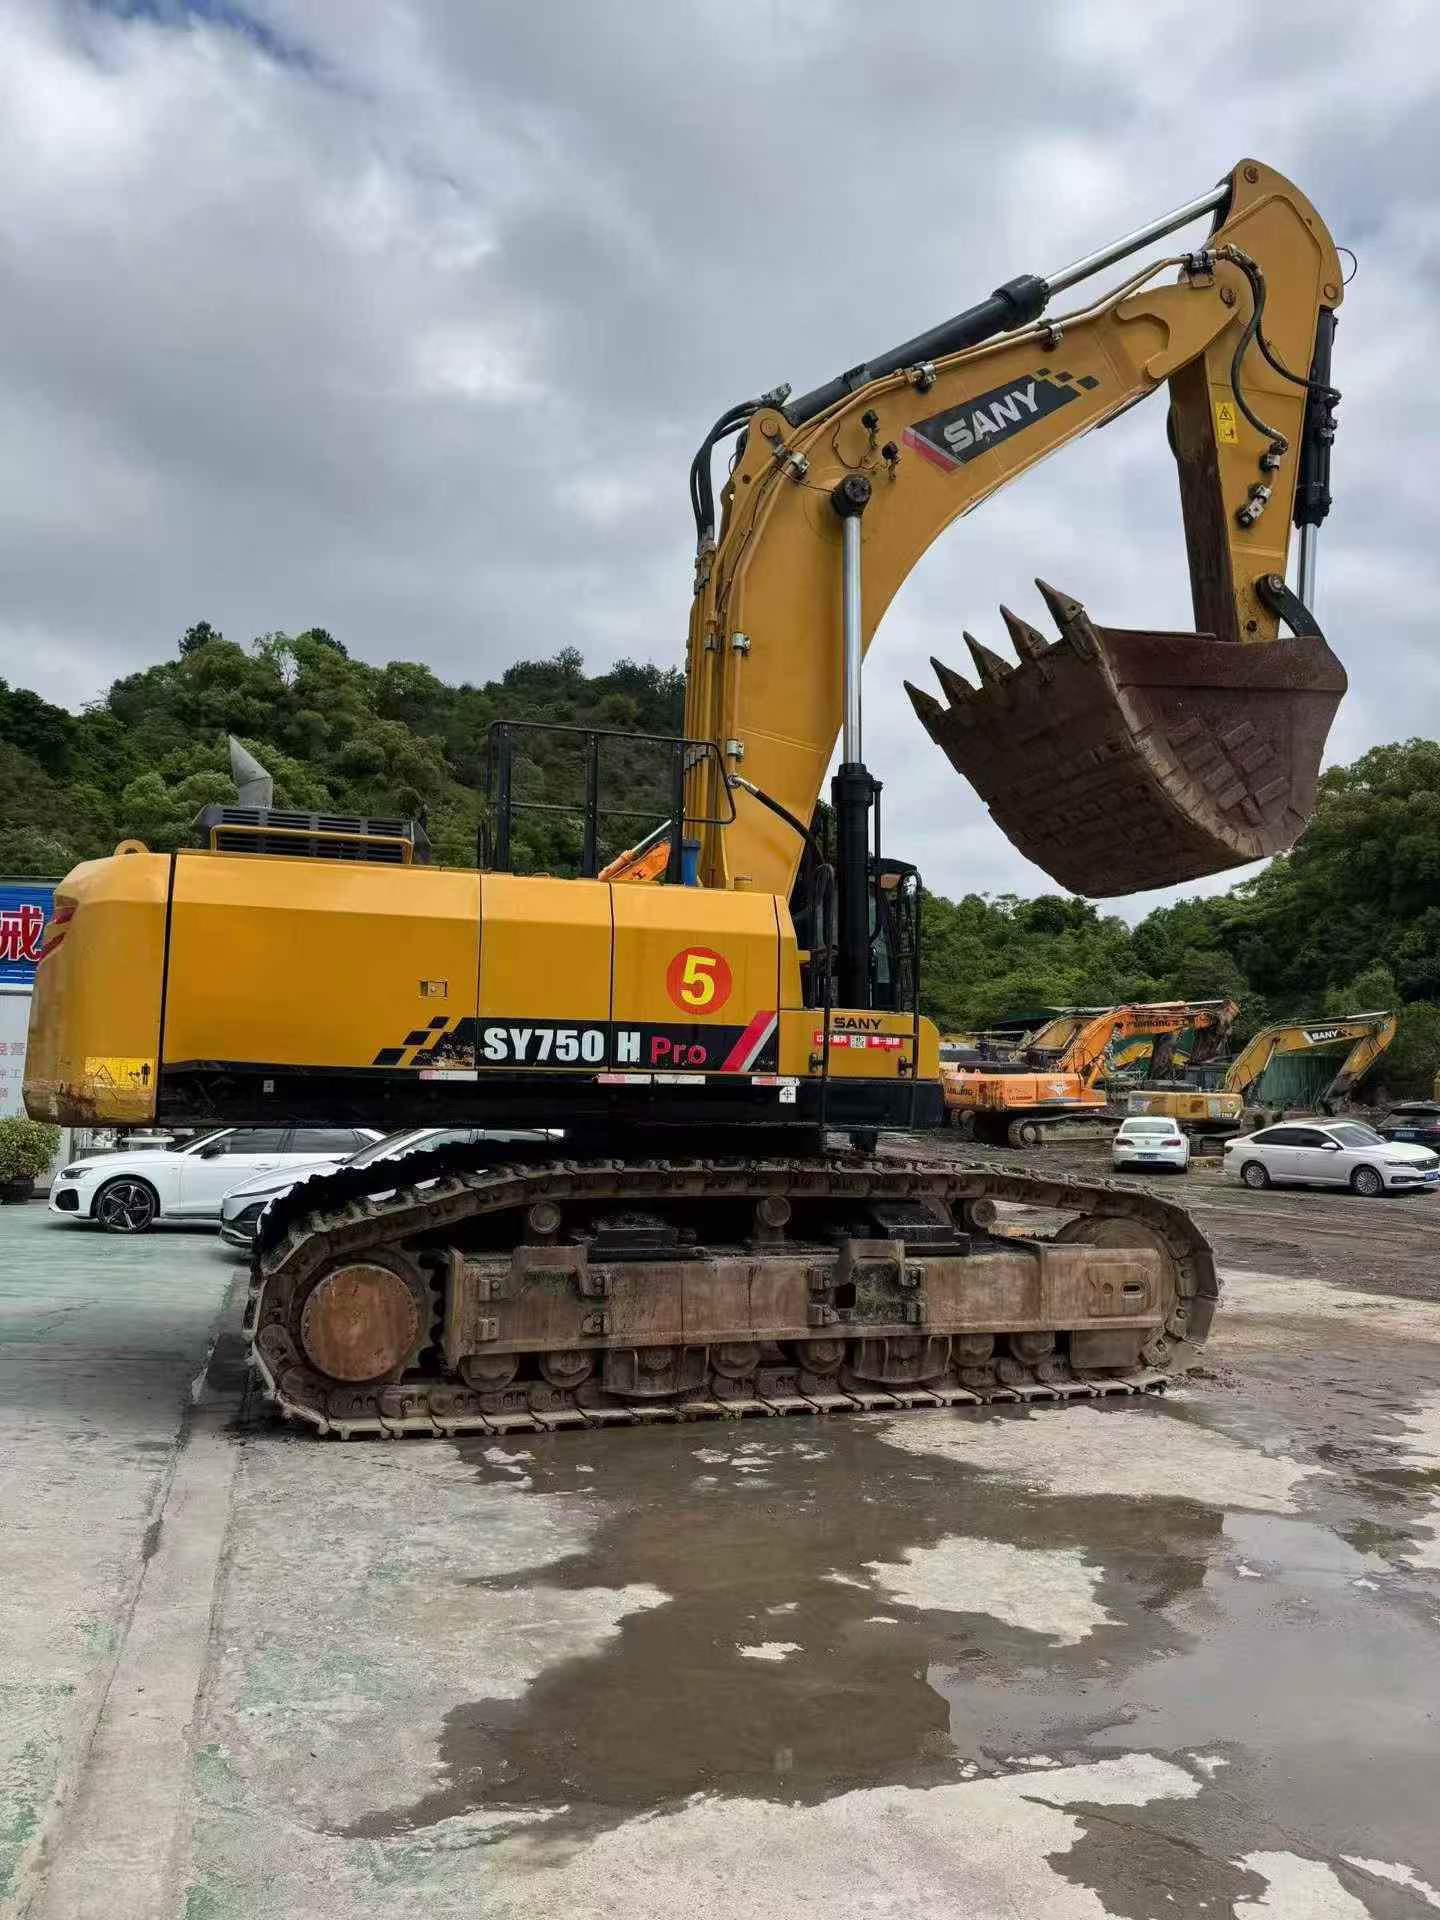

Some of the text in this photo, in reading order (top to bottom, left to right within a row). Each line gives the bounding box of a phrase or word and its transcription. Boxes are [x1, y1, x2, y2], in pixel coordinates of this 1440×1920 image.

[943, 382, 1039, 452] SANY
[680, 954, 717, 1006] 5
[483, 1027, 707, 1064] SY750 H Pro
[834, 1017, 882, 1030] SANY
